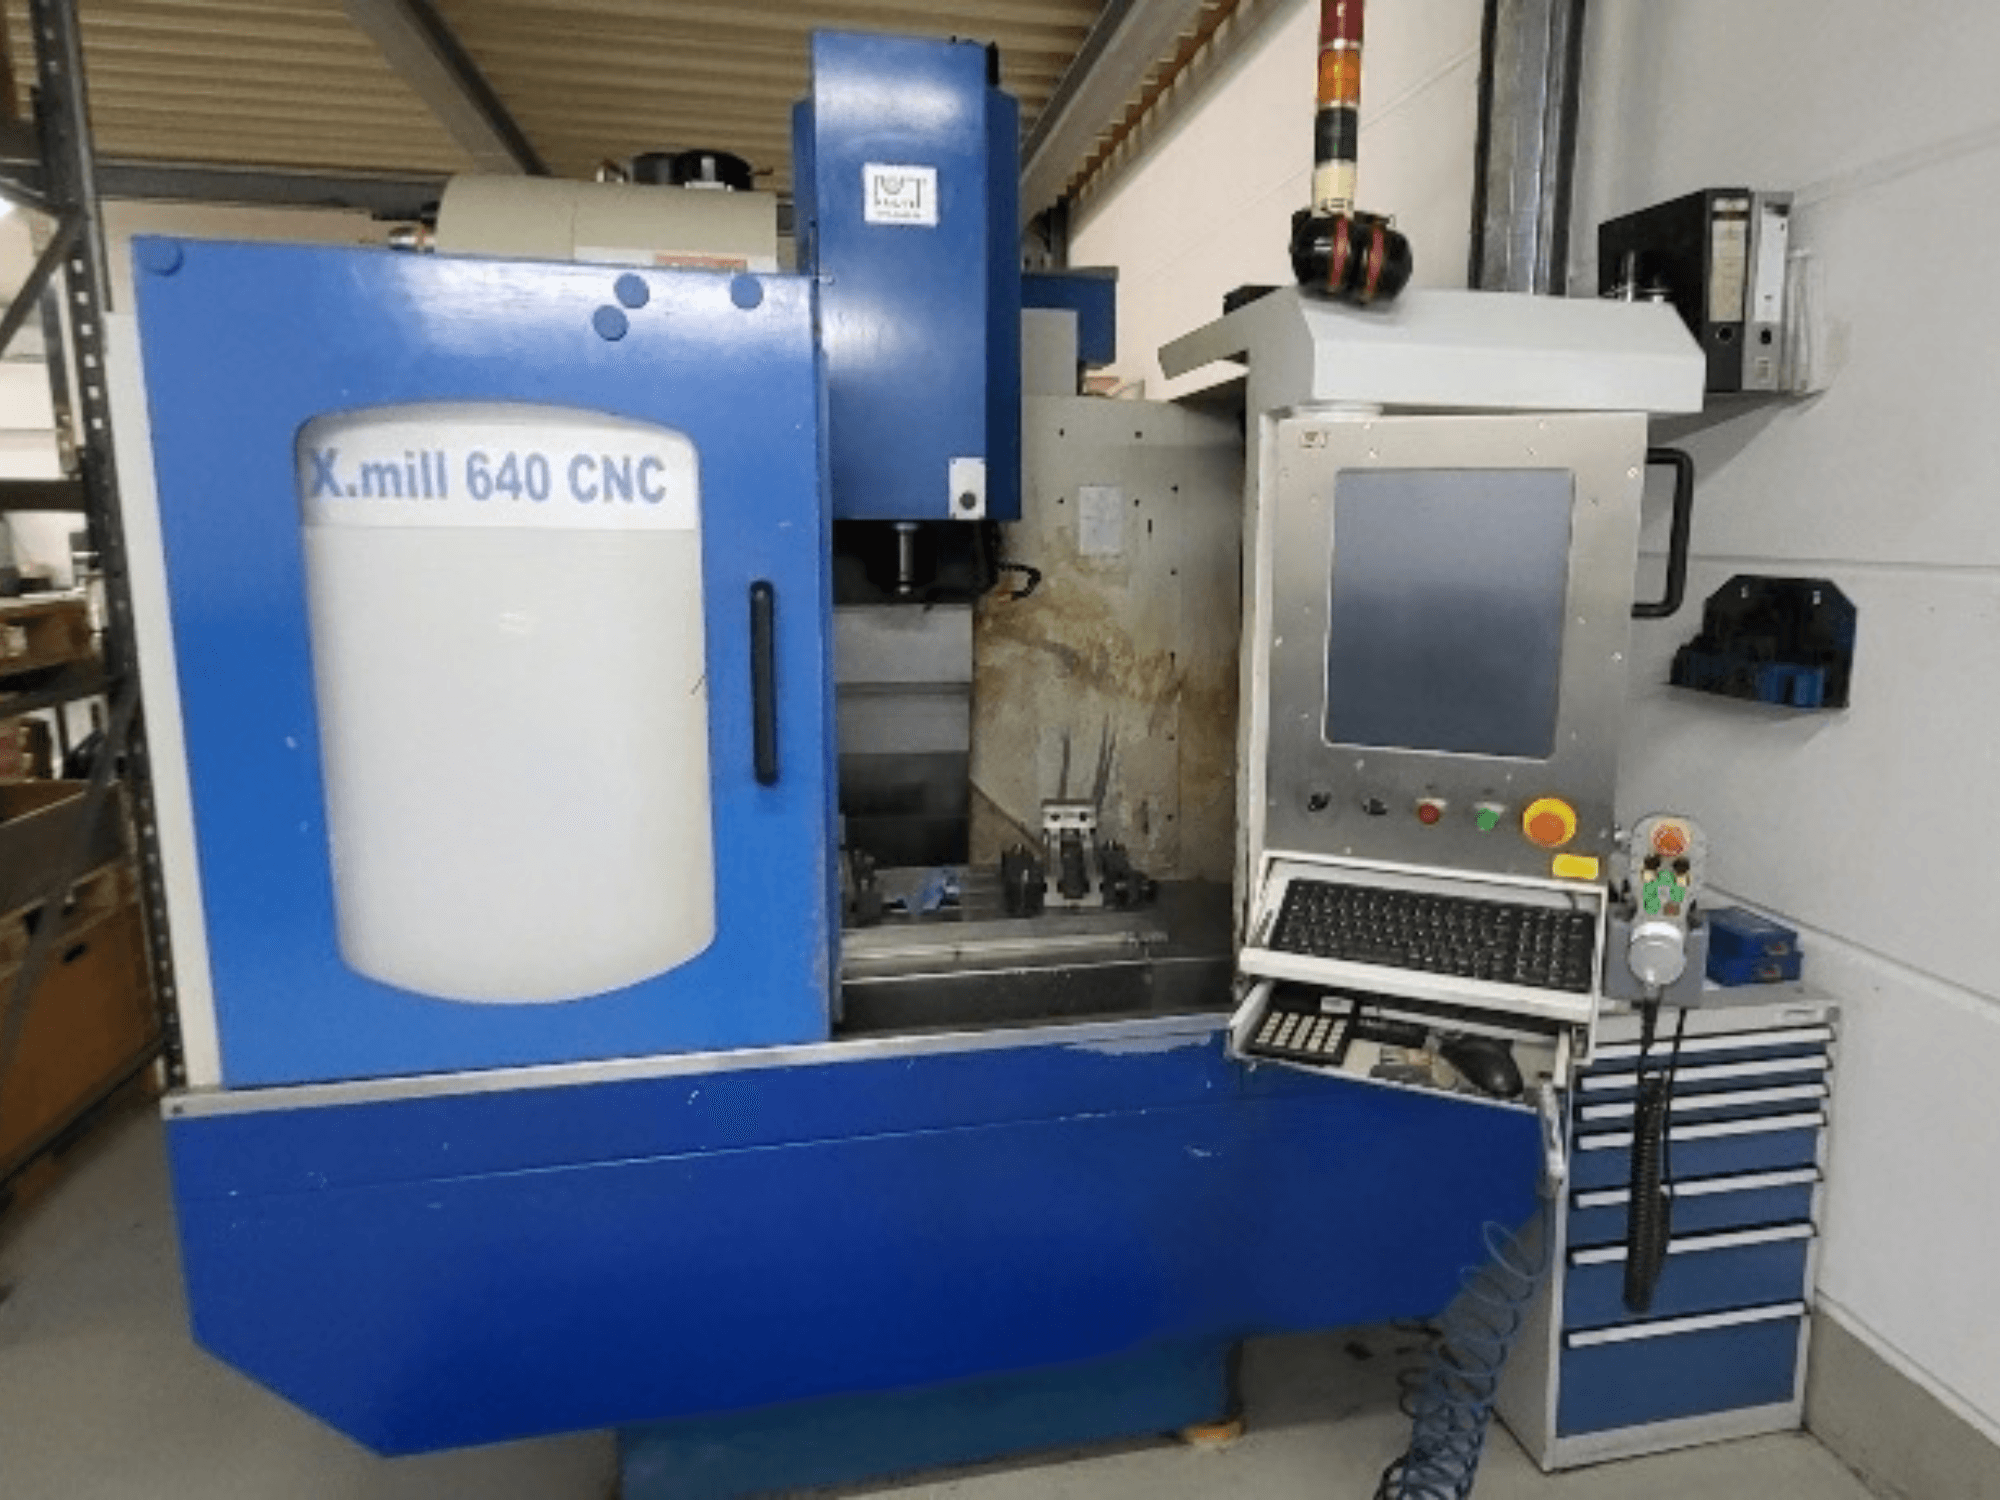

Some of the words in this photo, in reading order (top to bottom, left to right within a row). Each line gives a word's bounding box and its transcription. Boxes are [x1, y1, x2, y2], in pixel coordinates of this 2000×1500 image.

[310, 449, 449, 499] X.mill
[465, 451, 551, 502] 640
[568, 454, 667, 504] CNC
